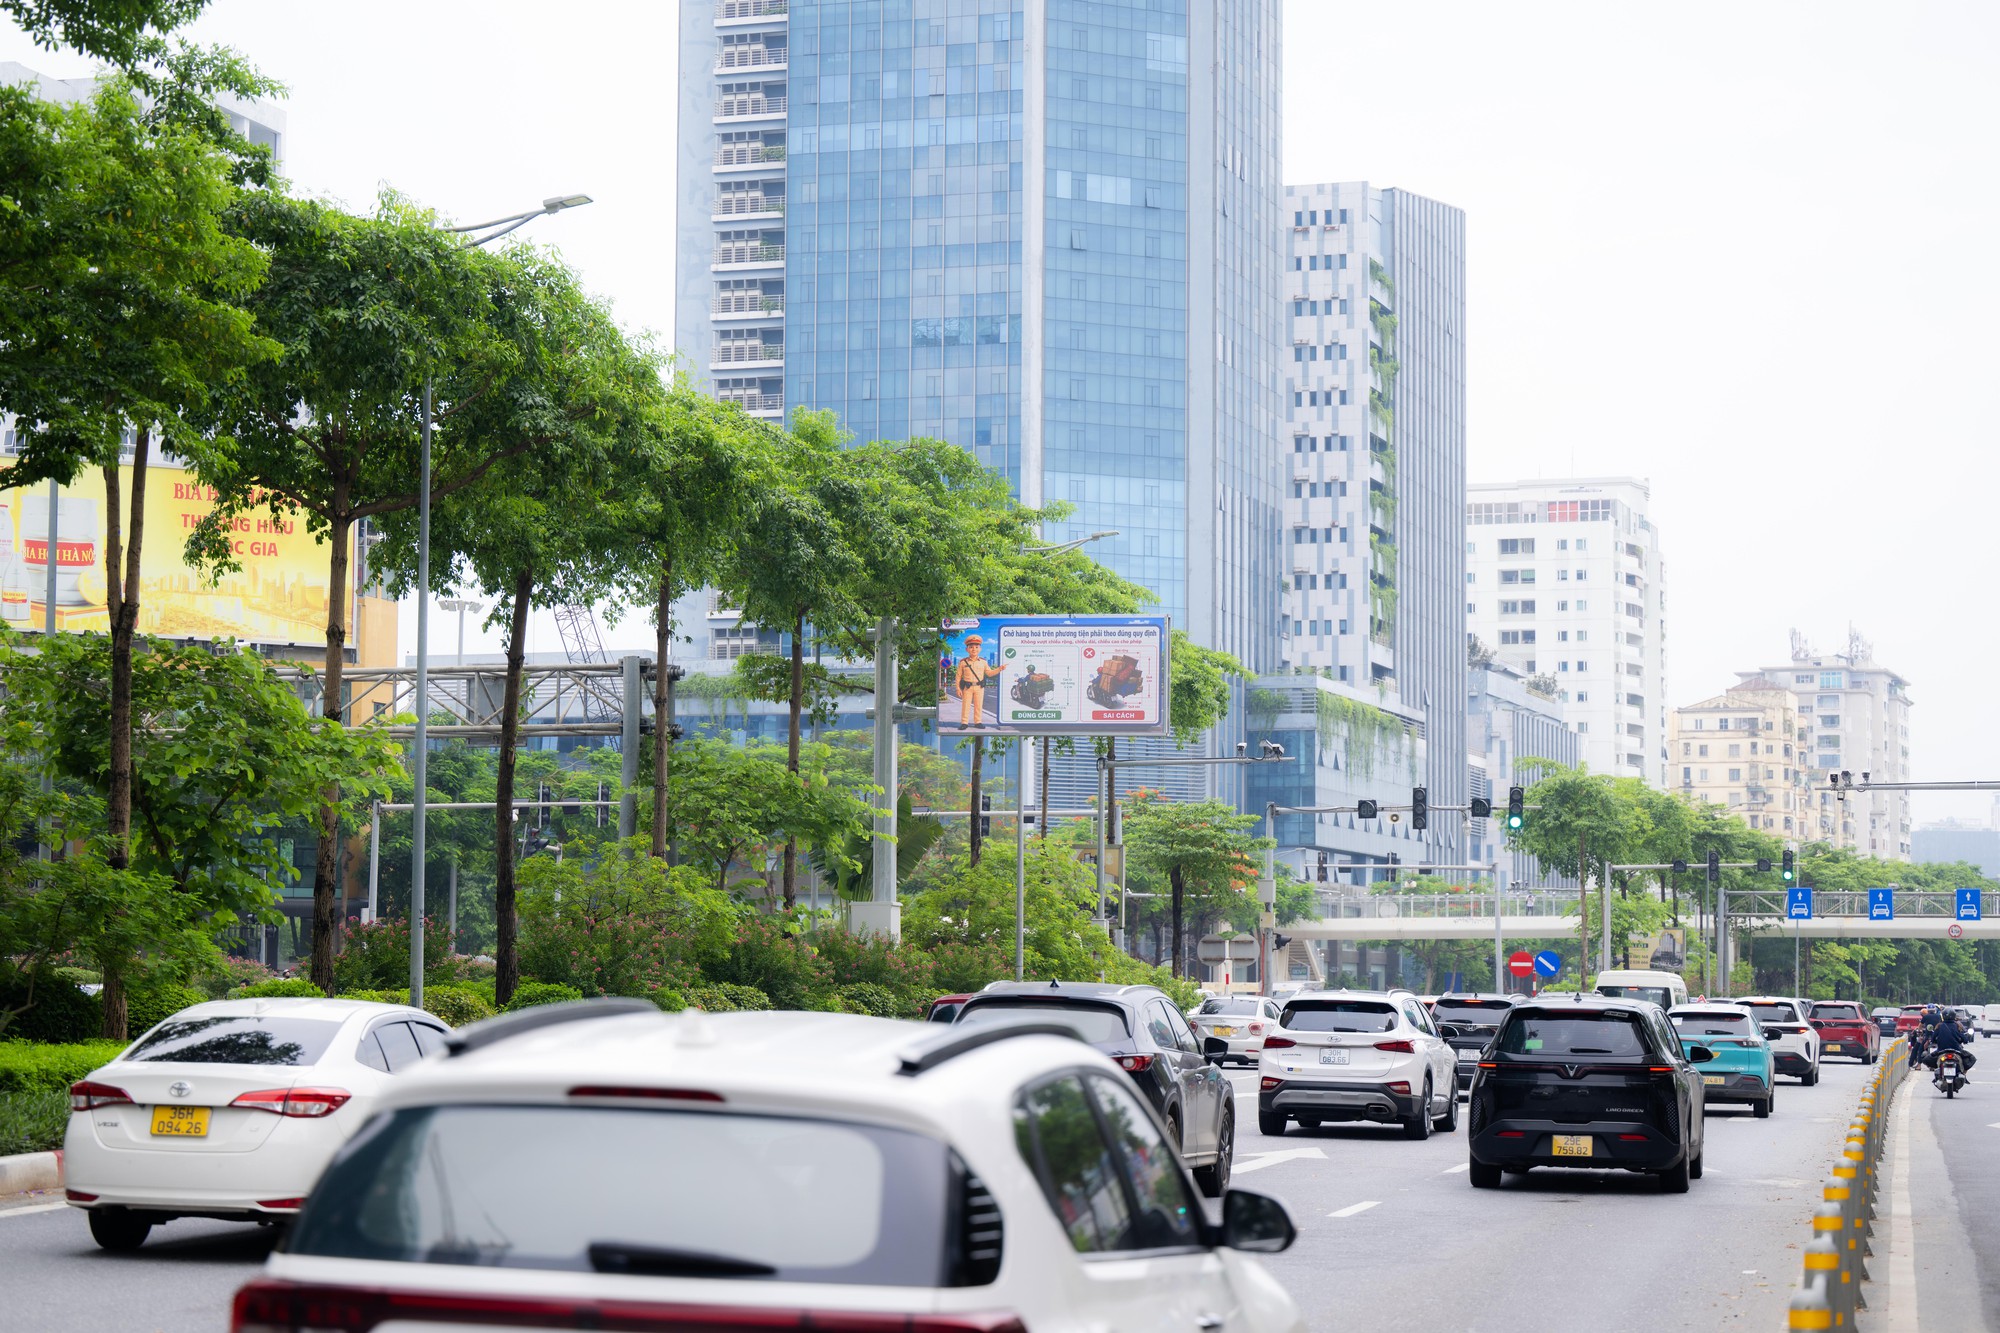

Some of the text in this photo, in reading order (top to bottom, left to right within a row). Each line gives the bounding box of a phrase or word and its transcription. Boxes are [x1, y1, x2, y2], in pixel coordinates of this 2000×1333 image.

[173, 482, 202, 501] BIA
[181, 513, 251, 533] THNG
[37, 548, 60, 561] HI
[62, 547, 80, 562] HÀ
[250, 541, 278, 557] GIA
[1016, 630, 1029, 638] hàng
[1078, 630, 1089, 638] tiện
[1090, 629, 1102, 638] phải
[1118, 630, 1132, 638] đúng
[1144, 630, 1156, 638] định
[169, 1107, 194, 1120] 36H
[157, 1120, 202, 1134] 094.26
[1564, 1137, 1581, 1146] 29E
[1556, 1146, 1588, 1155] 759.82
